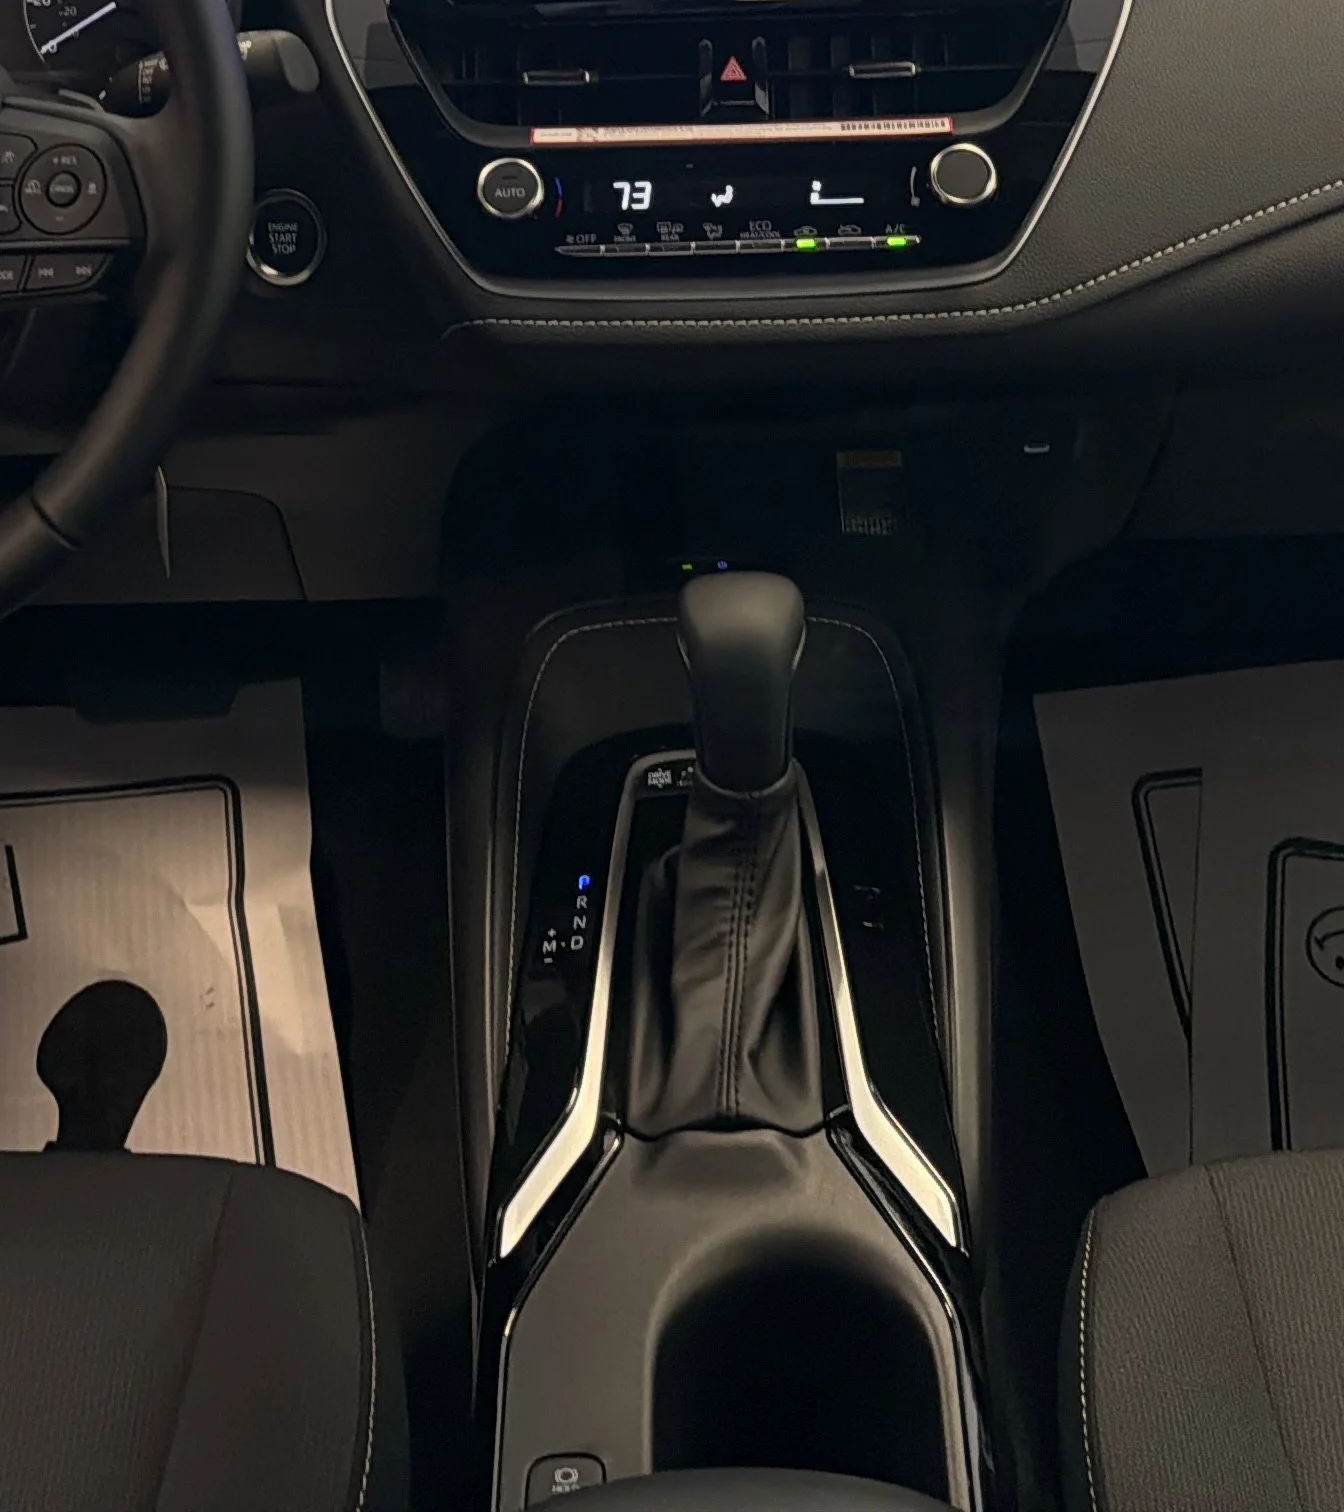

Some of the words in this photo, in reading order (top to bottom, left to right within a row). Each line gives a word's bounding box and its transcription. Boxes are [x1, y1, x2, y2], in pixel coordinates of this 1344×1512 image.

[494, 187, 526, 199] AUTO
[612, 180, 653, 211] 73
[749, 220, 772, 231] ECO
[885, 223, 907, 234] A/C
[268, 232, 297, 243] START
[575, 233, 597, 244] OFF
[271, 243, 296, 255] STOP
[578, 874, 591, 890] P
[576, 895, 588, 909] R
[573, 915, 587, 930] N
[542, 939, 557, 955] M
[570, 935, 584, 951] D
